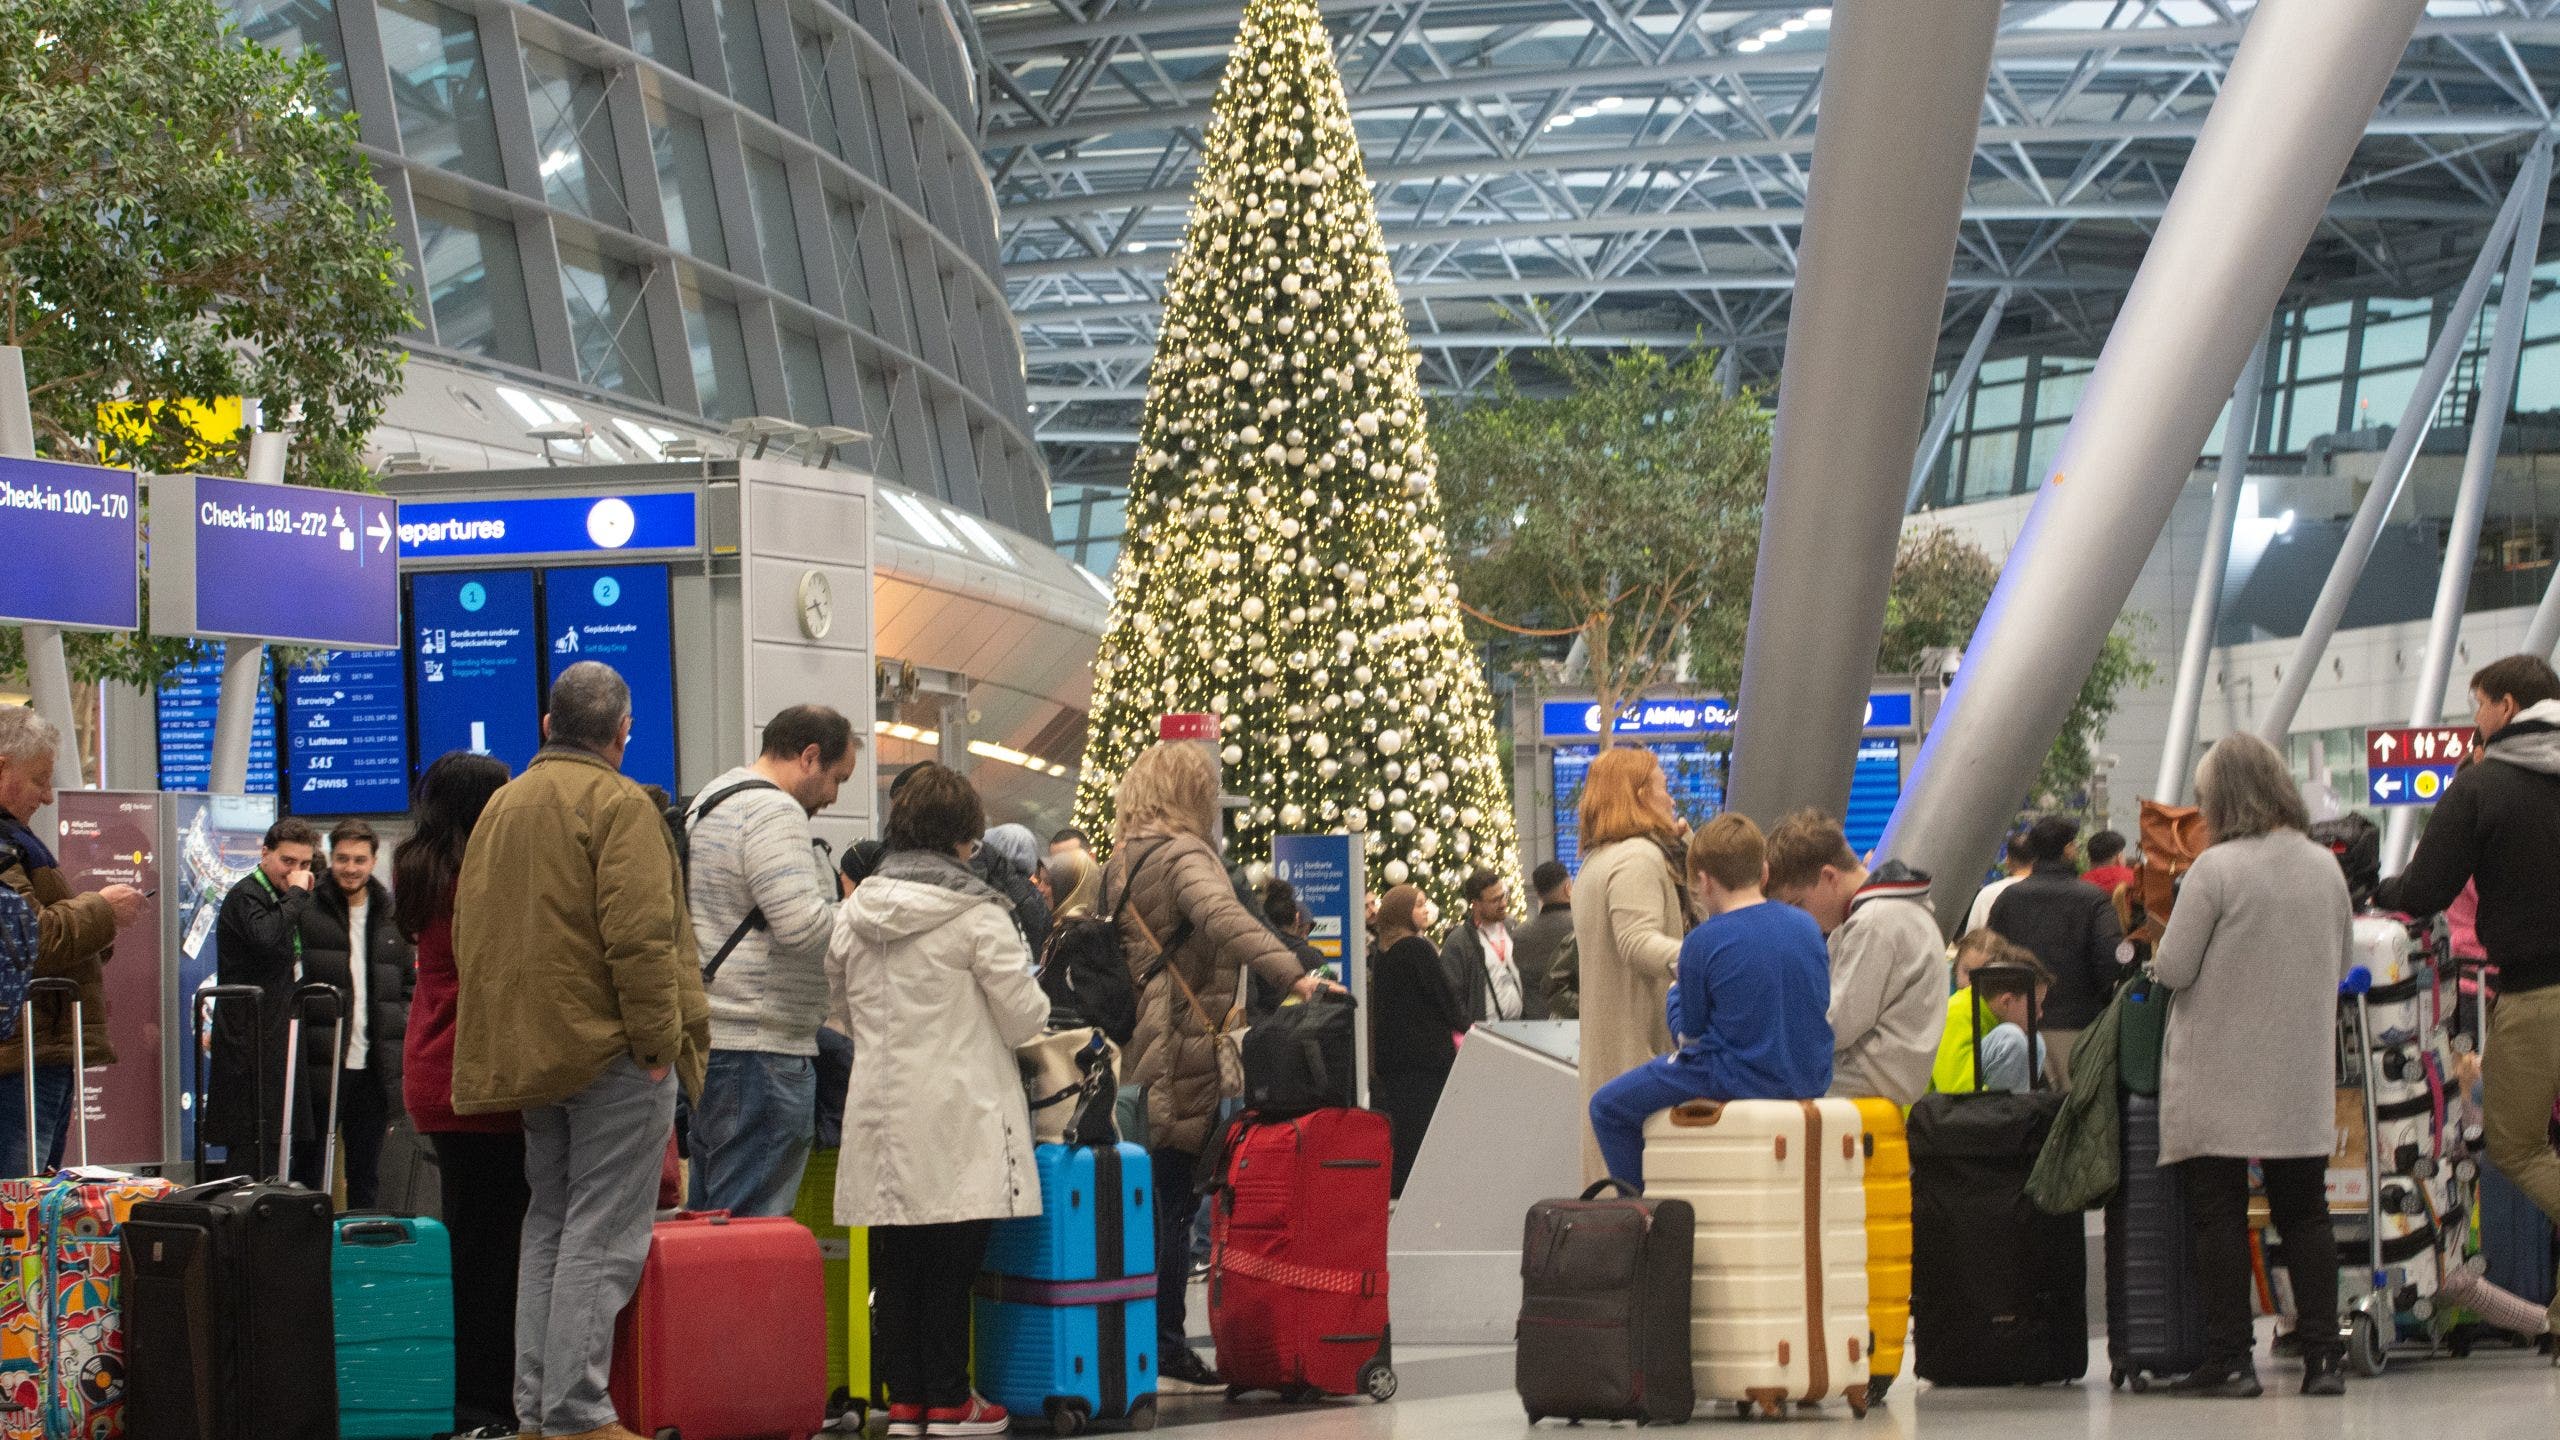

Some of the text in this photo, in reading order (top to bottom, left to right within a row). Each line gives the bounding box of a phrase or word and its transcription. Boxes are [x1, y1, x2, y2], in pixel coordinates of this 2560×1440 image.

[0, 481, 61, 511] Check-in
[201, 501, 264, 530] Check-in
[398, 518, 505, 548] epartures
[469, 591, 476, 603] 1
[602, 585, 610, 598] 2
[298, 674, 330, 684] condor
[296, 697, 335, 707] Eurowings
[1643, 706, 1695, 728] Abflug
[308, 720, 330, 728] KLM
[308, 737, 348, 746] Lufthansa
[308, 756, 334, 769] SAS
[317, 778, 348, 788] SWISS
